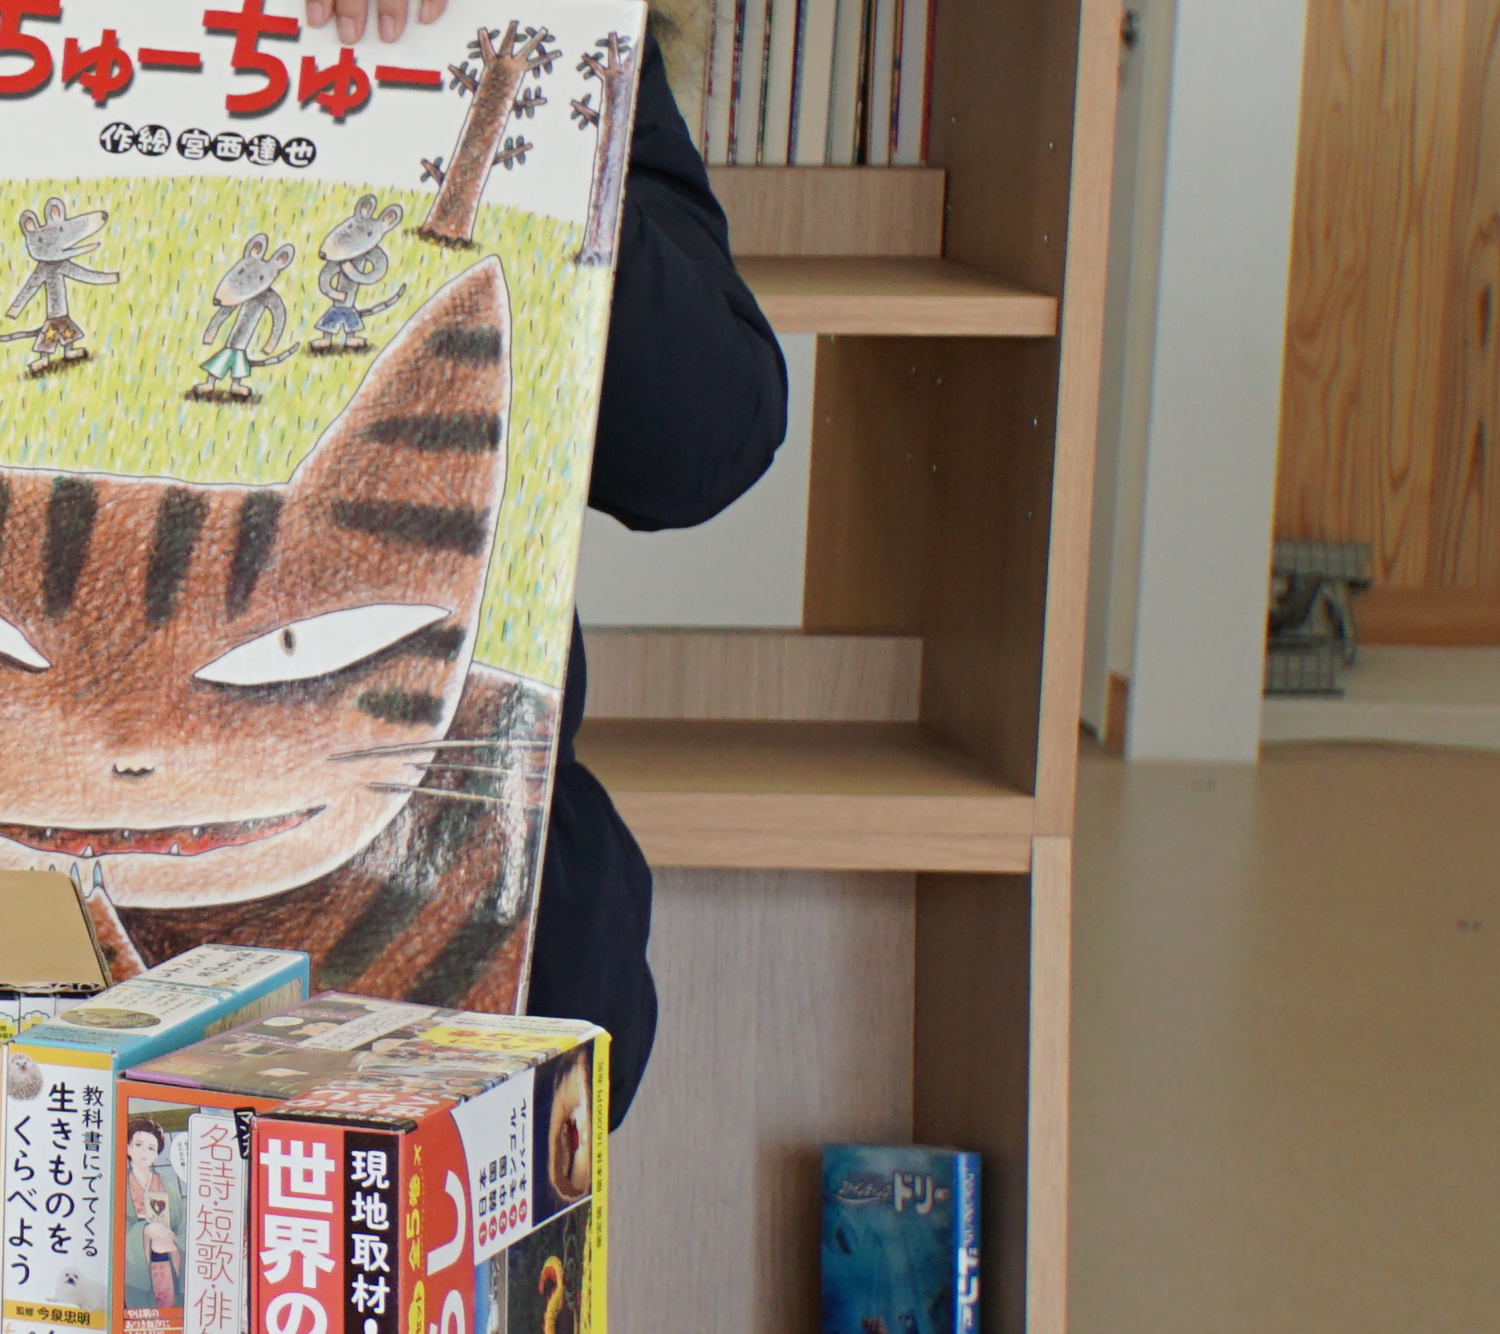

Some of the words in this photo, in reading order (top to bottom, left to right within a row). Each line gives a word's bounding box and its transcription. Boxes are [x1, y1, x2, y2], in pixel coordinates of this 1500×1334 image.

[176, 127, 318, 169] 宮西達也
[6, 1114, 38, 1286] くらべよう
[45, 1081, 78, 1255] 生きものを
[81, 1084, 105, 1258] 教科書にでてくる
